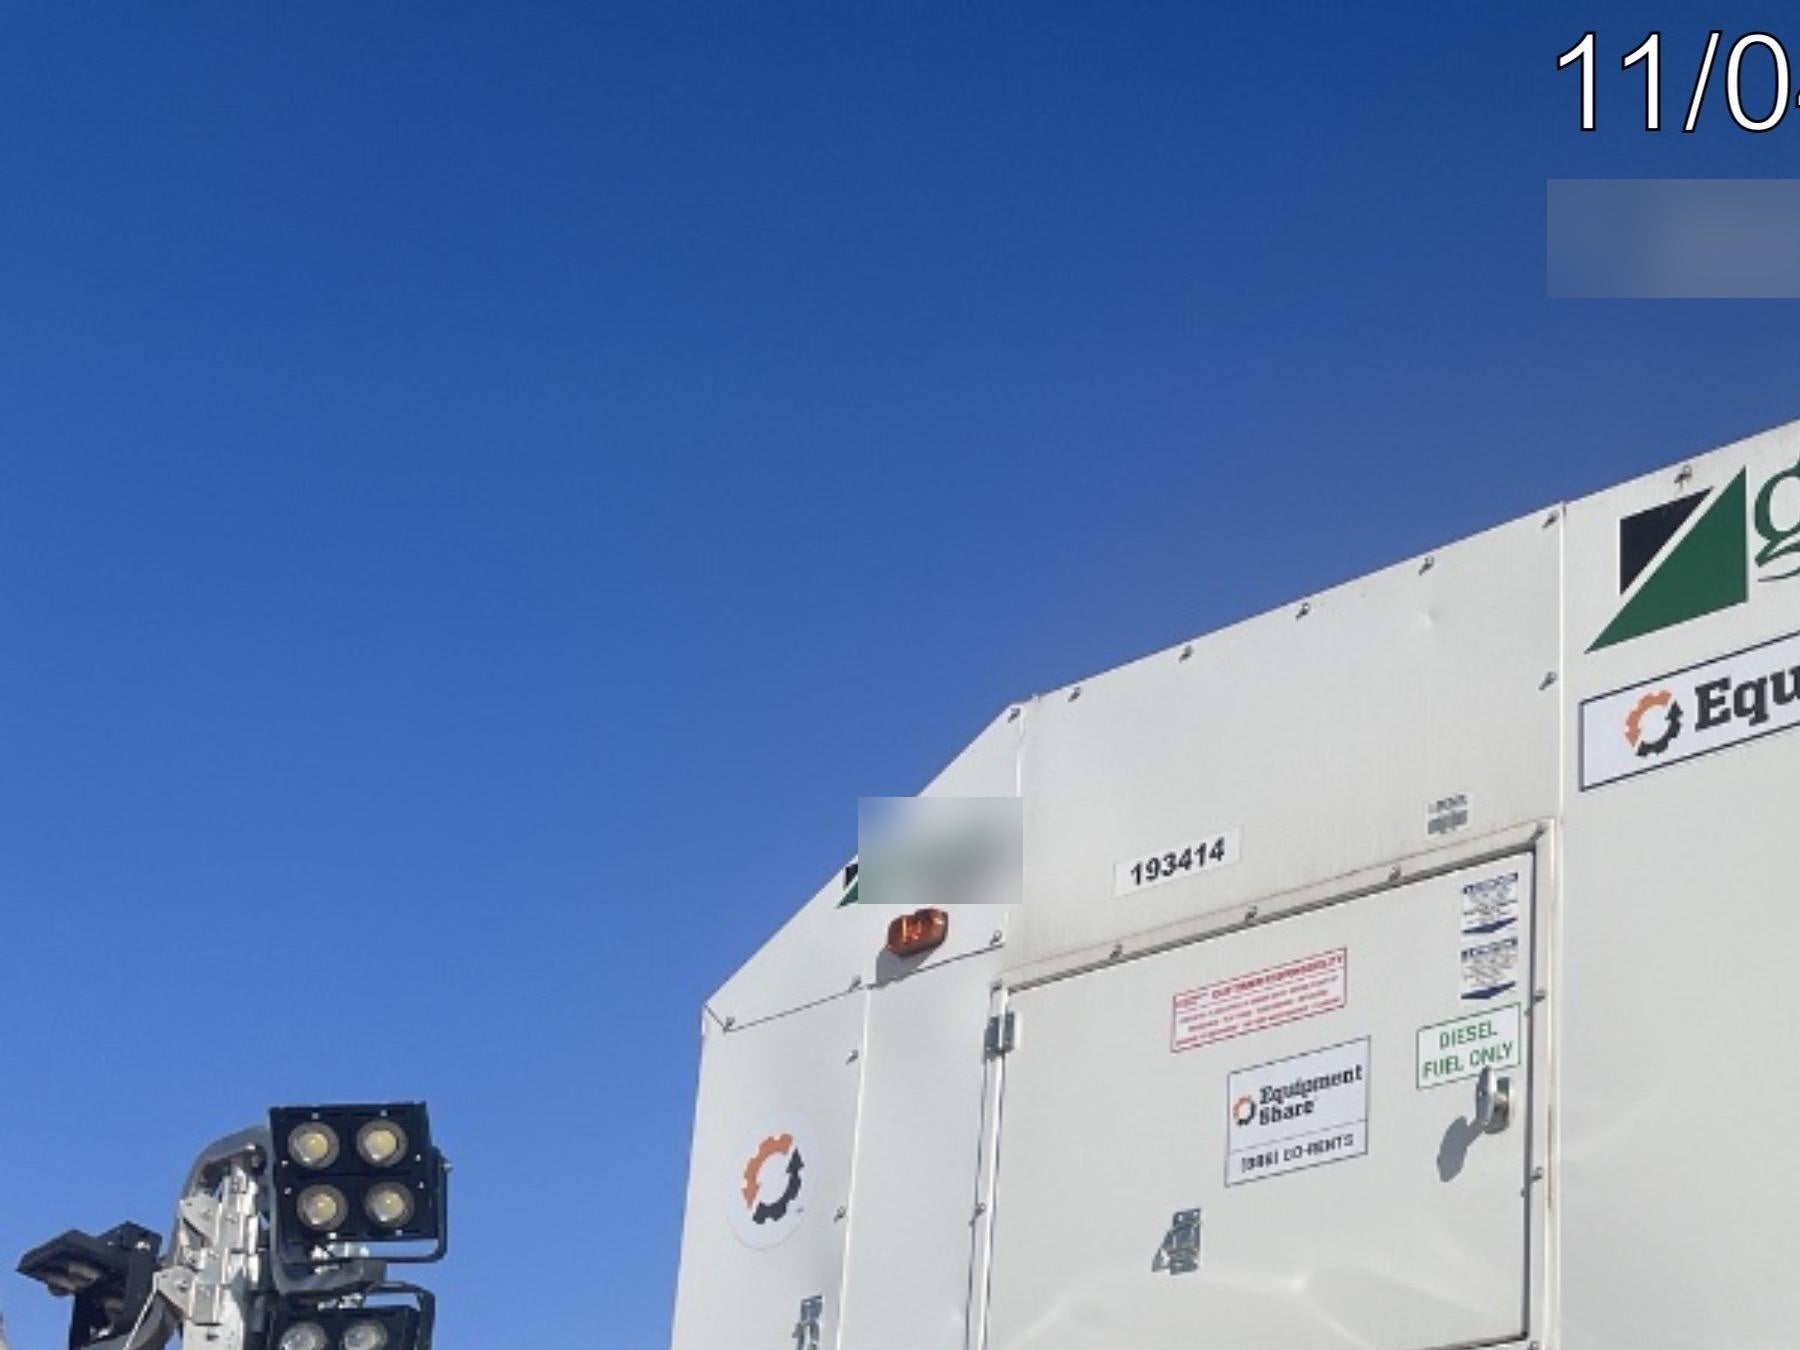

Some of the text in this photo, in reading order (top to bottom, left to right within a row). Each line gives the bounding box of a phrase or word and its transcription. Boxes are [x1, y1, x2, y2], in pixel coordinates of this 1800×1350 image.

[1129, 836, 1226, 887] 193414
[1439, 1020, 1498, 1051] DIESEL
[1423, 1040, 1513, 1079] FUEL ONLY
[1259, 1064, 1363, 1105] Equipment
